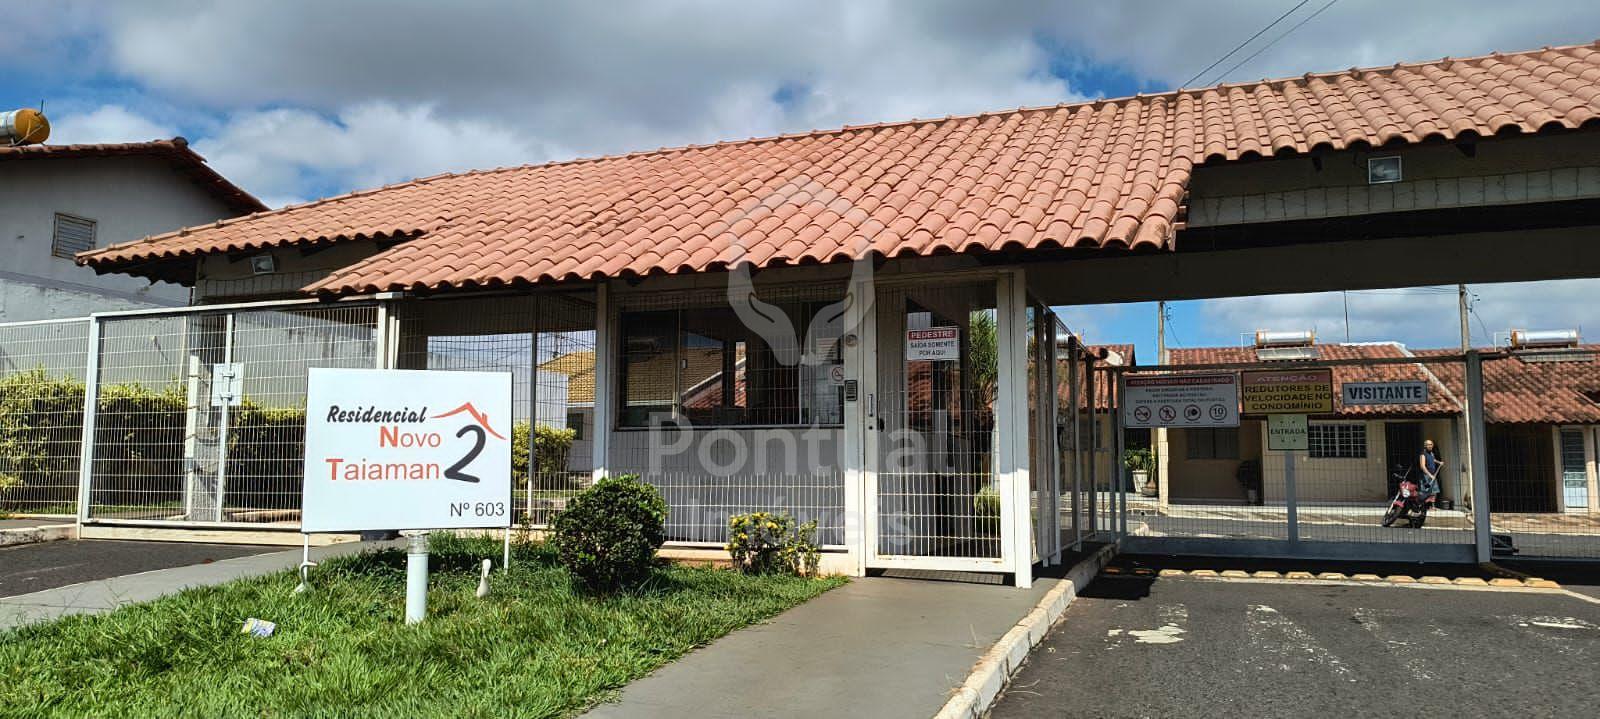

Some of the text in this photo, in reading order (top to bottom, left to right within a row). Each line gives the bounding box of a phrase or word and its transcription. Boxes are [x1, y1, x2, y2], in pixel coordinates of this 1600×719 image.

[911, 330, 954, 339] PEDESTRE
[927, 340, 955, 348] SOMENTE
[1256, 374, 1317, 383] ATENÇÃO
[1244, 384, 1329, 393] REDUTORES DE
[1348, 386, 1422, 400] VISITANTE
[1244, 392, 1331, 402] VELOCIDADE NO
[1252, 401, 1323, 410] CONDOMÍNIO
[326, 405, 428, 423] Residencial
[1213, 407, 1224, 415] 10
[1270, 427, 1307, 435] ENTRADA
[379, 425, 441, 448] Novo
[325, 424, 486, 483] Taiaman 2
[474, 502, 505, 517] 603
